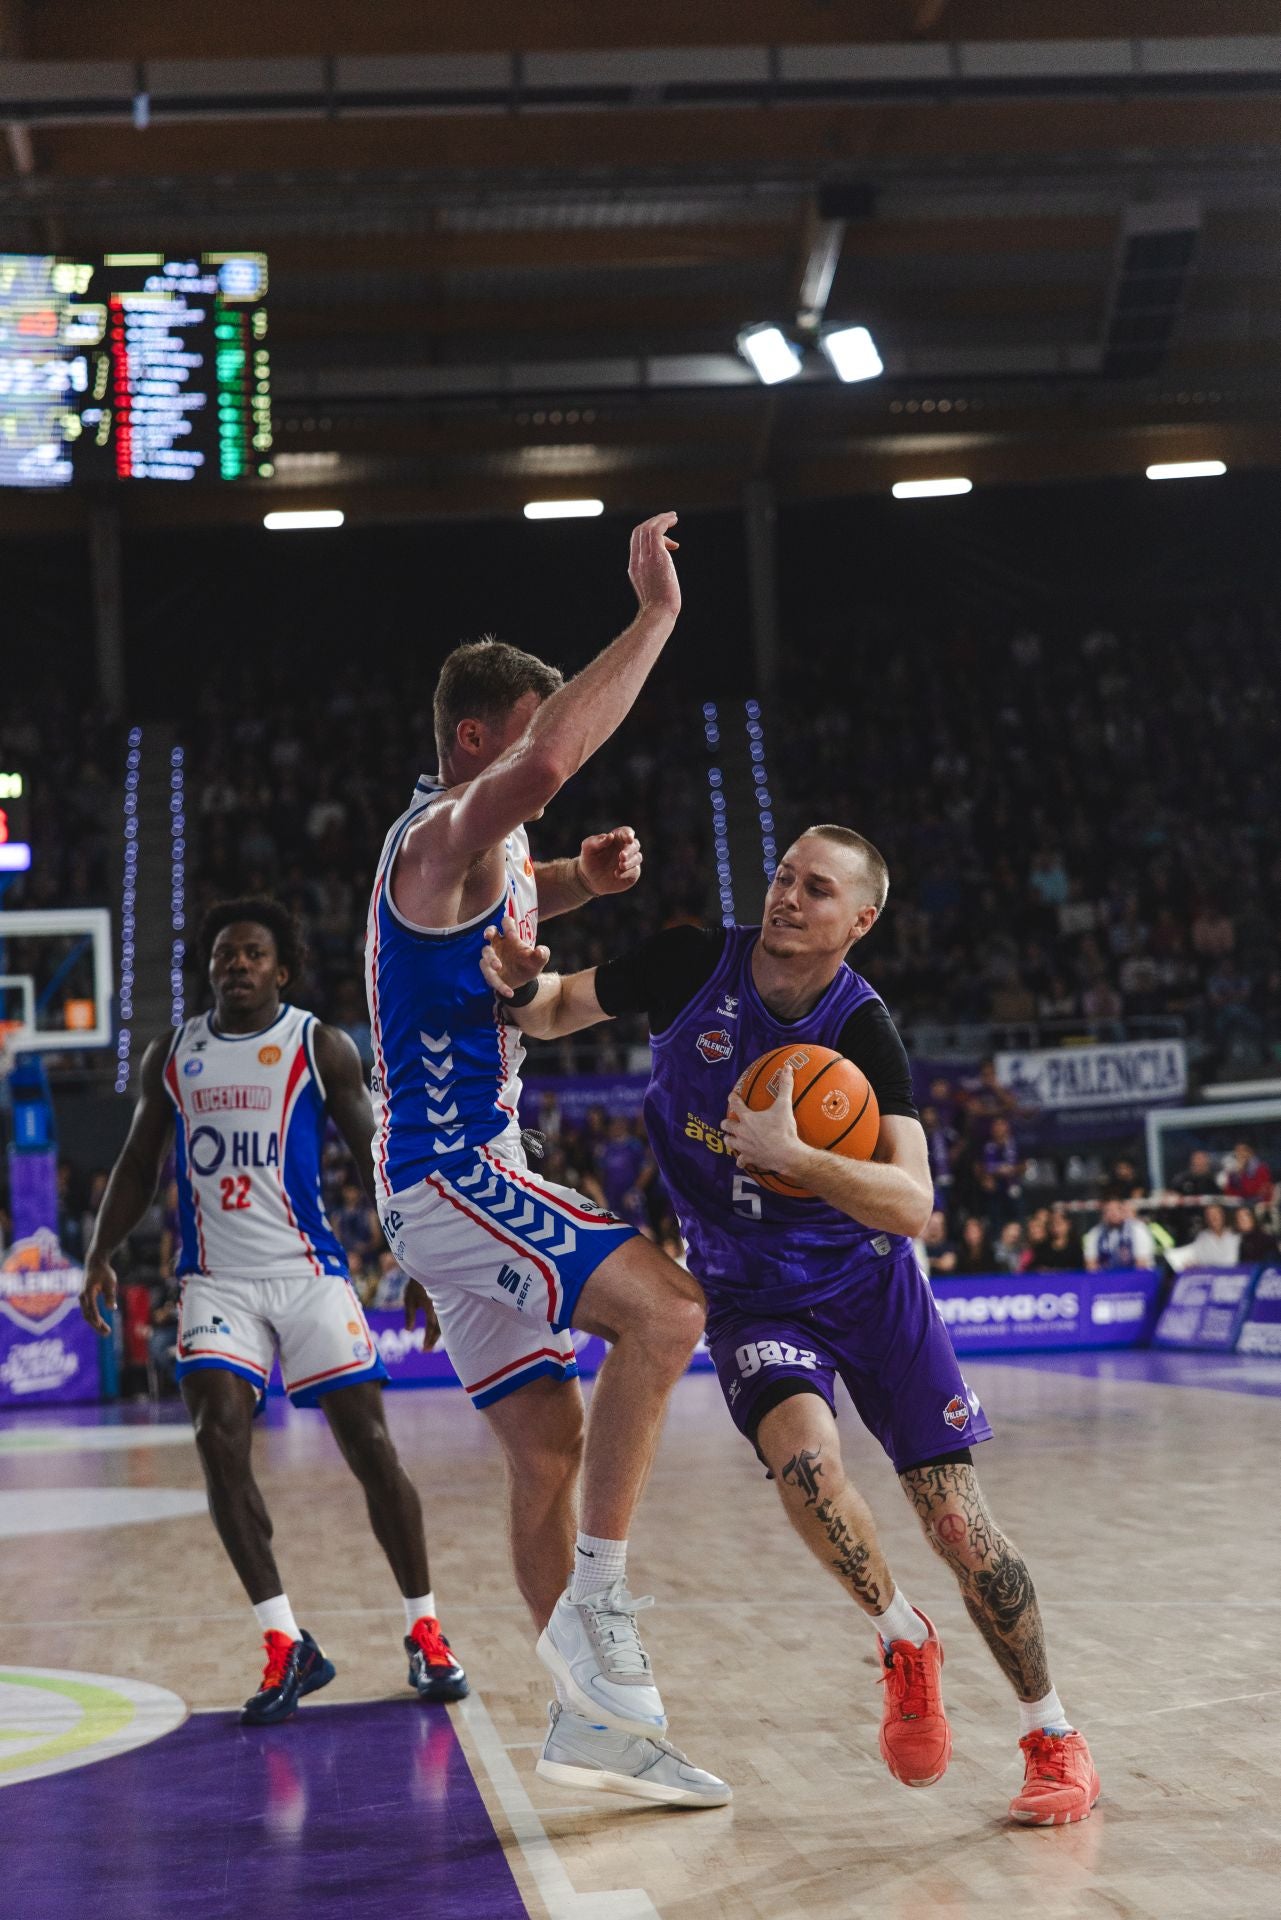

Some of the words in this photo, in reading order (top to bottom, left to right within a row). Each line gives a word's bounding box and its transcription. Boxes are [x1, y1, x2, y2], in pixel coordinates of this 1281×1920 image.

[699, 1036, 731, 1057] PALENCIA
[231, 1130, 279, 1168] HLA
[219, 1174, 252, 1212] 22
[732, 1174, 763, 1221] 5
